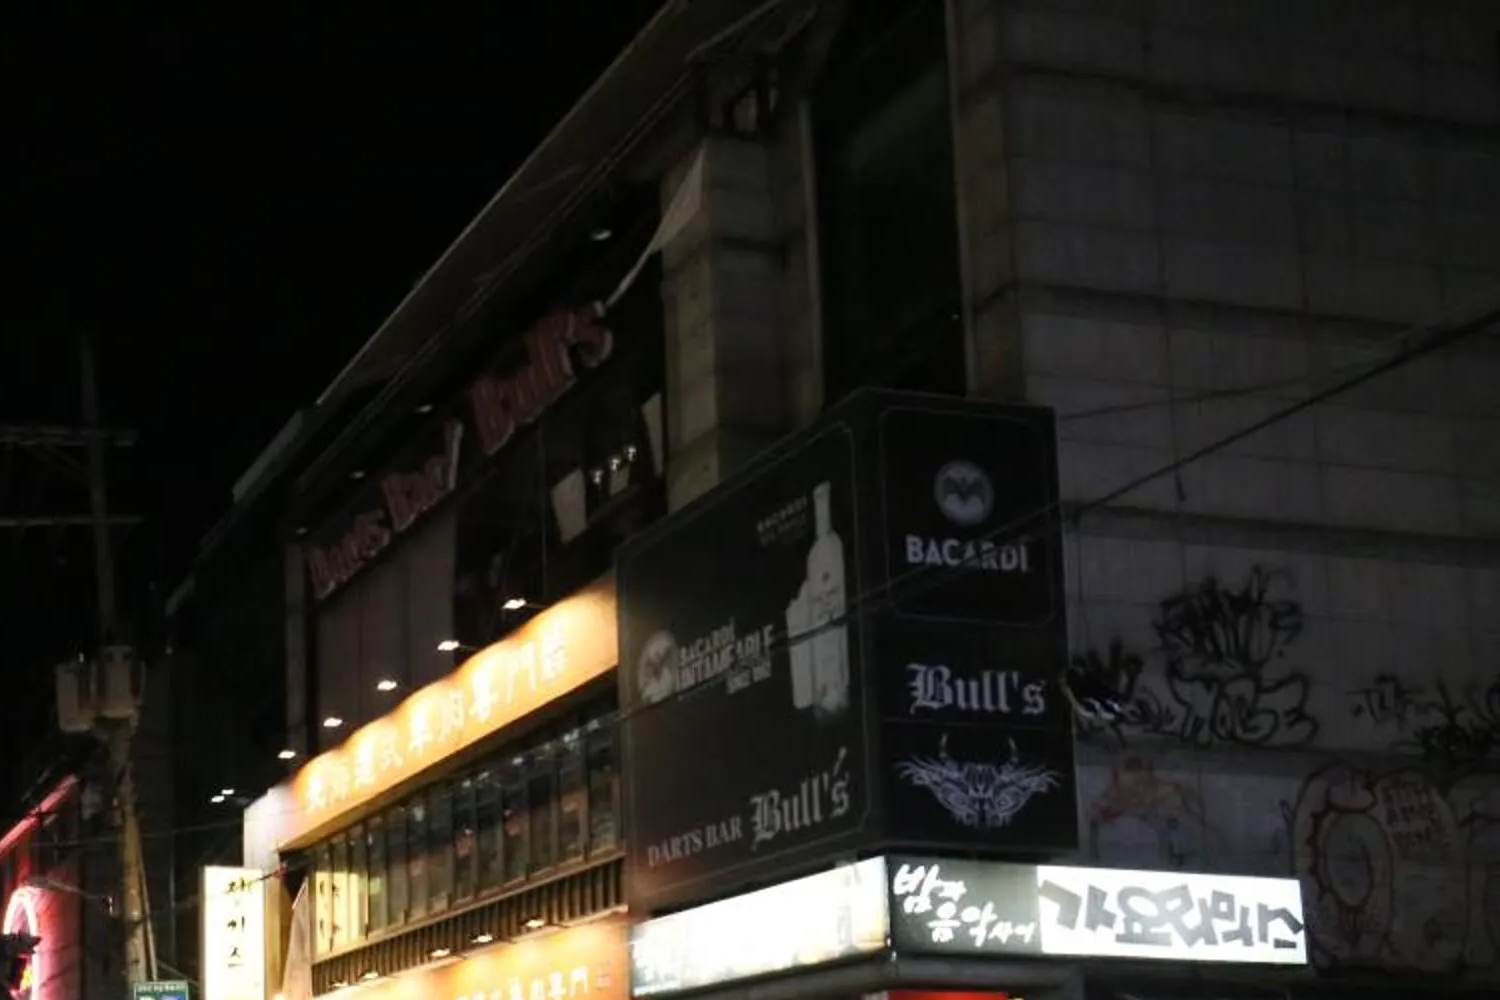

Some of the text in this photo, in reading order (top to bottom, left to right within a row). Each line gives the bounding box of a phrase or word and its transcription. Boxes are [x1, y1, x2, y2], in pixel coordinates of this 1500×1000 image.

[904, 661, 1047, 716] Bull's
[647, 828, 705, 868] DARTS
[748, 769, 850, 851] Bull's
